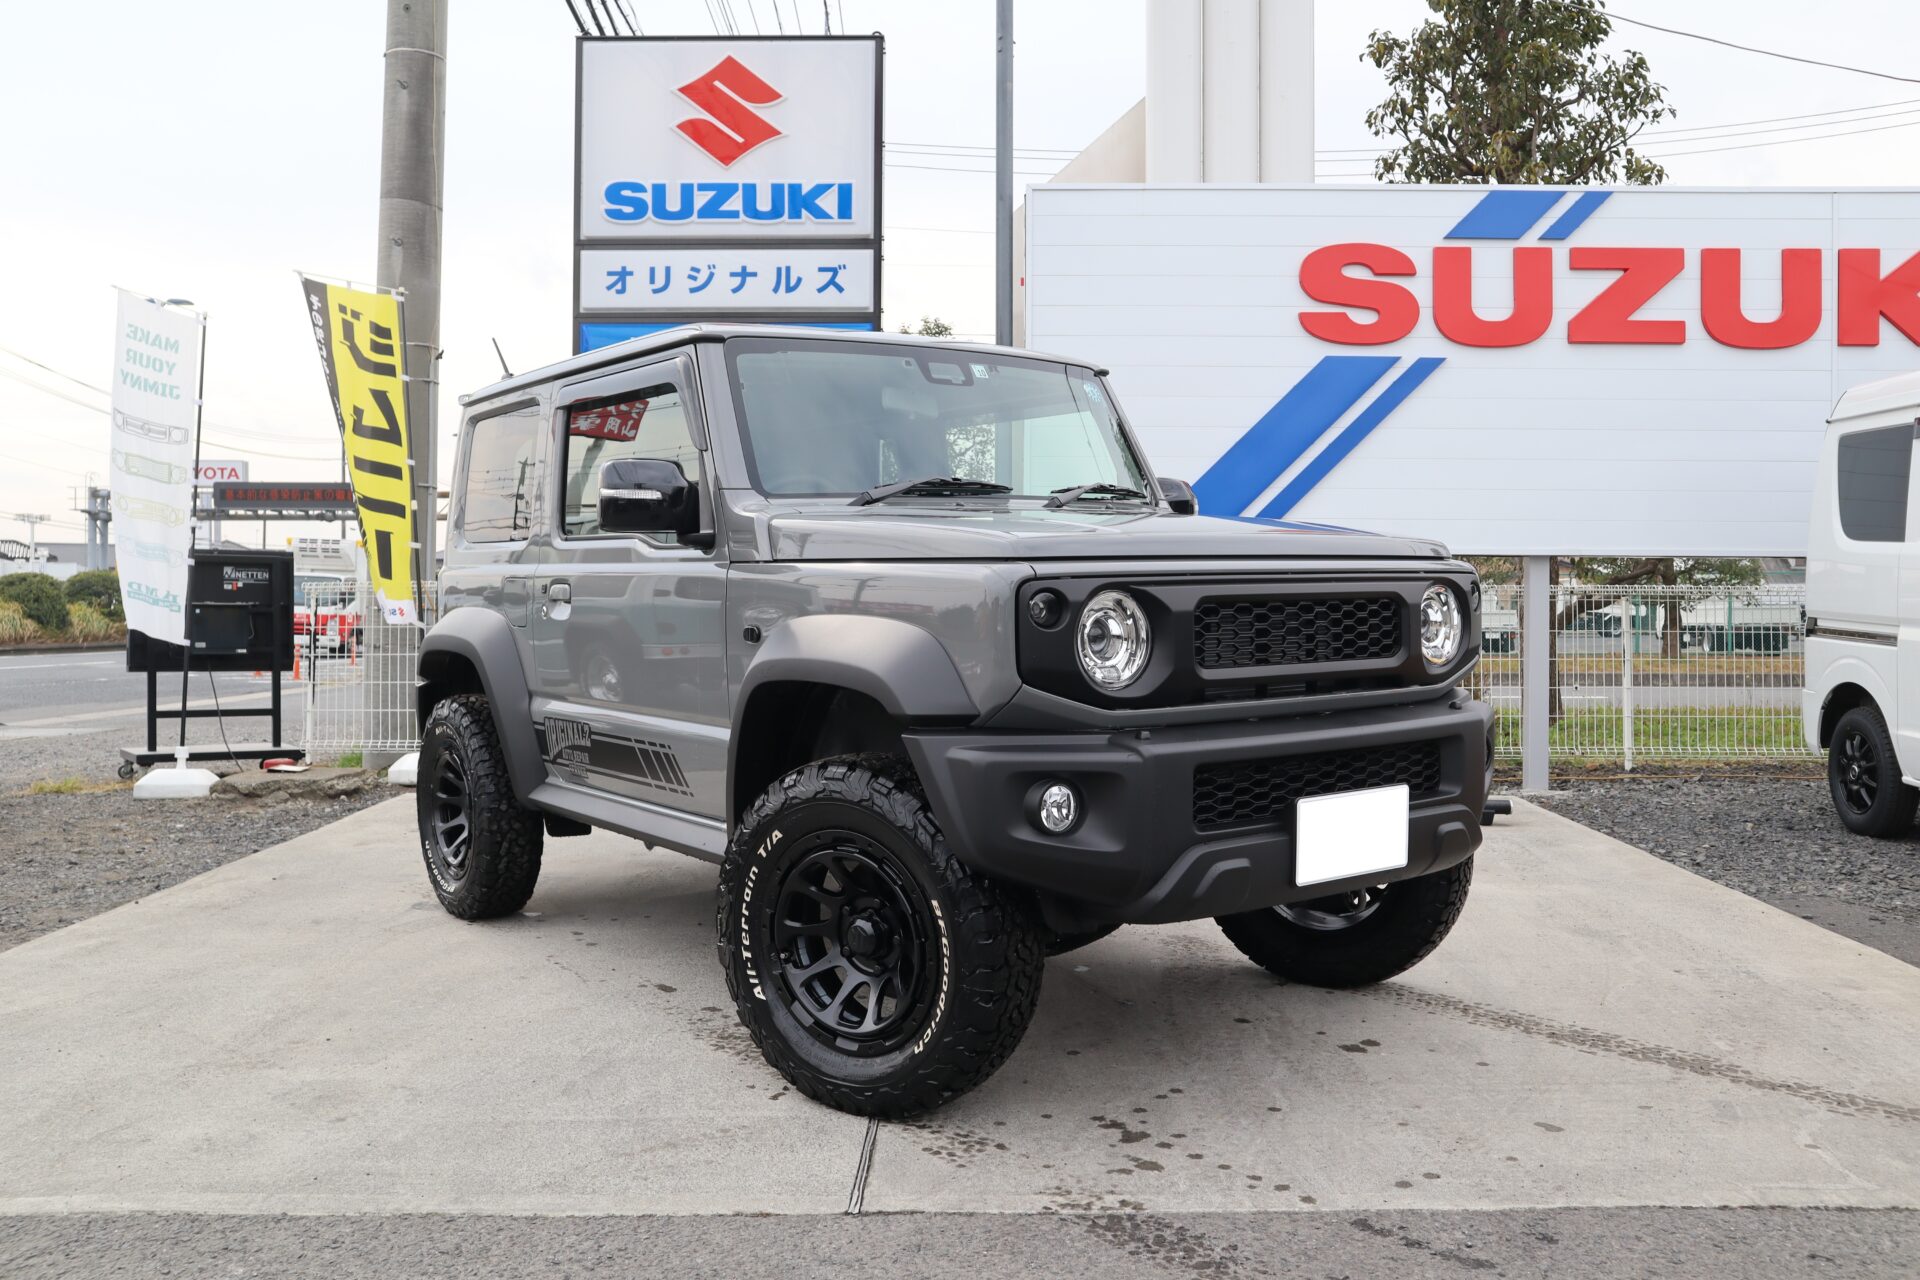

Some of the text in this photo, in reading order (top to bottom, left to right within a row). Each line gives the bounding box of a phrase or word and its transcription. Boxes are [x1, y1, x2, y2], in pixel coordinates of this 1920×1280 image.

[603, 181, 853, 221] SUZUKI
[604, 263, 848, 296] オリジナルズ
[1298, 242, 1920, 349] SUZUK
[235, 571, 269, 579] NETTEN
[741, 829, 784, 1001] All-Terrain T/A
[913, 899, 950, 1055] BFGoodrich
